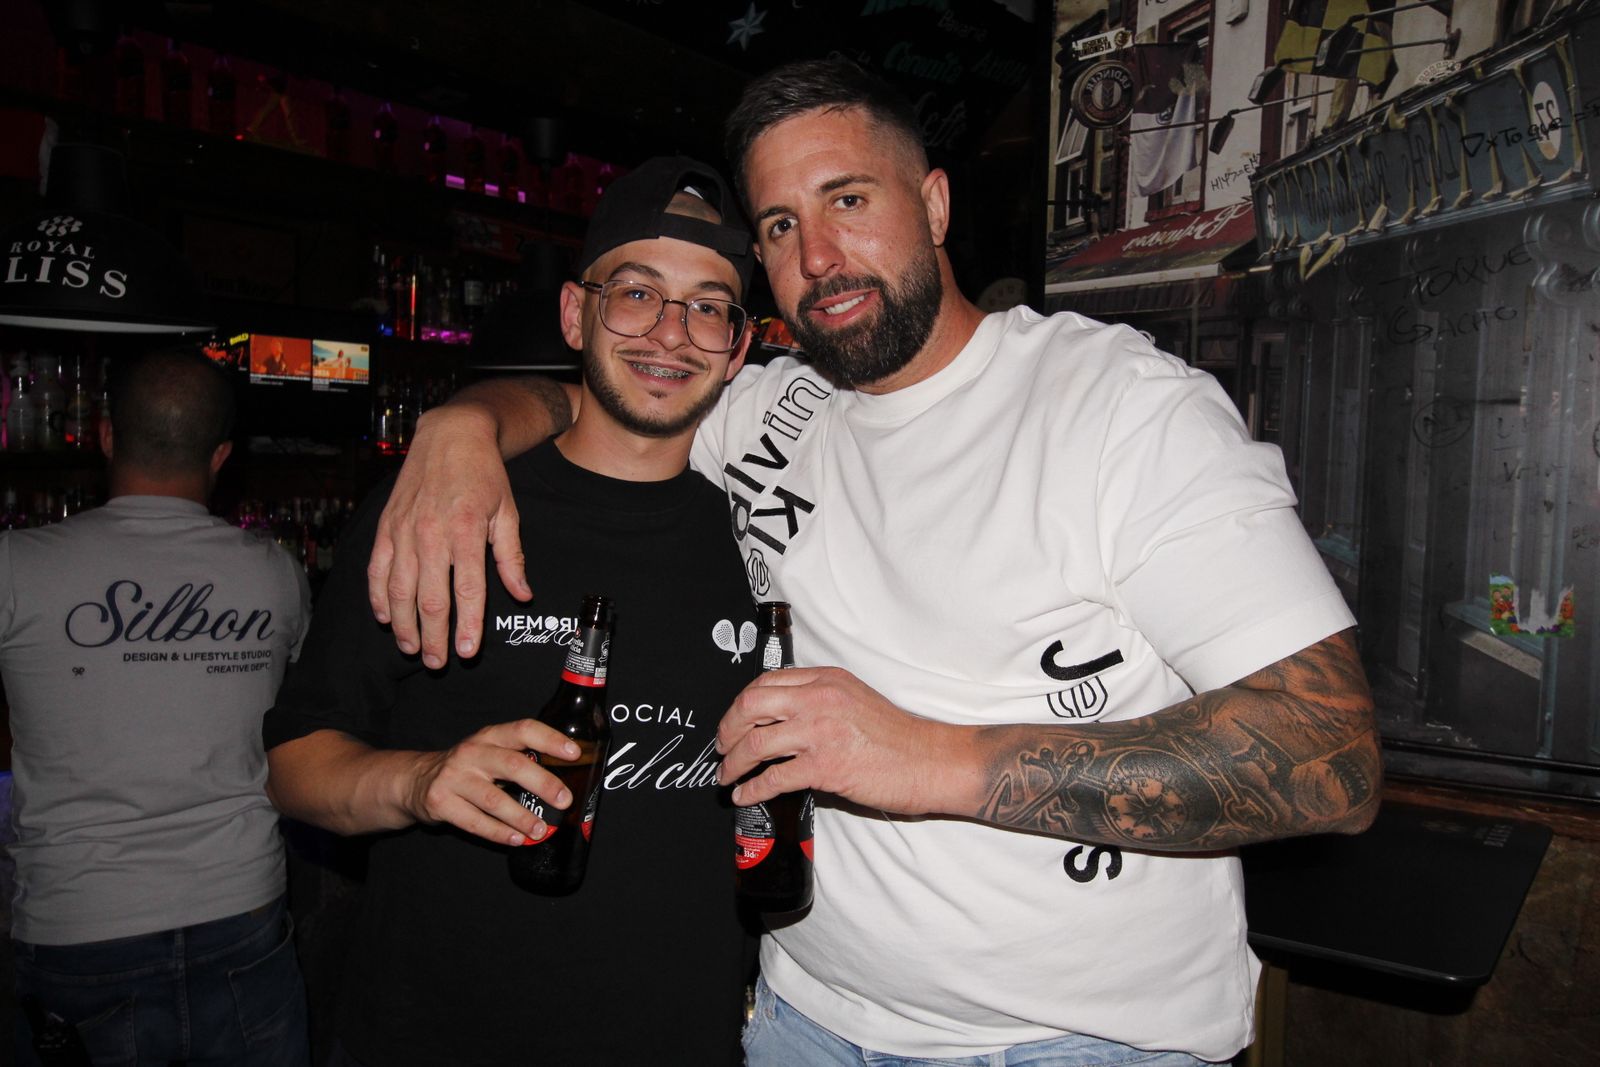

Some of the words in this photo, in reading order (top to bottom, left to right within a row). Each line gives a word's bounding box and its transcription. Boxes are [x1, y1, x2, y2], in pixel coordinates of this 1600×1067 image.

[10, 241, 95, 259] ROYAL
[4, 256, 127, 298] LISS
[724, 376, 831, 542] alvin
[746, 485, 816, 597] Kle
[65, 580, 275, 648] Silbon
[496, 615, 579, 632] MEMORI
[123, 652, 168, 662] DESIGN
[171, 651, 180, 662] &
[183, 651, 239, 661] LIFESTYLE
[241, 650, 272, 660] STUDIO
[206, 663, 249, 674] CREATIVE
[611, 703, 697, 729] OCIAL
[655, 736, 720, 791] clu
